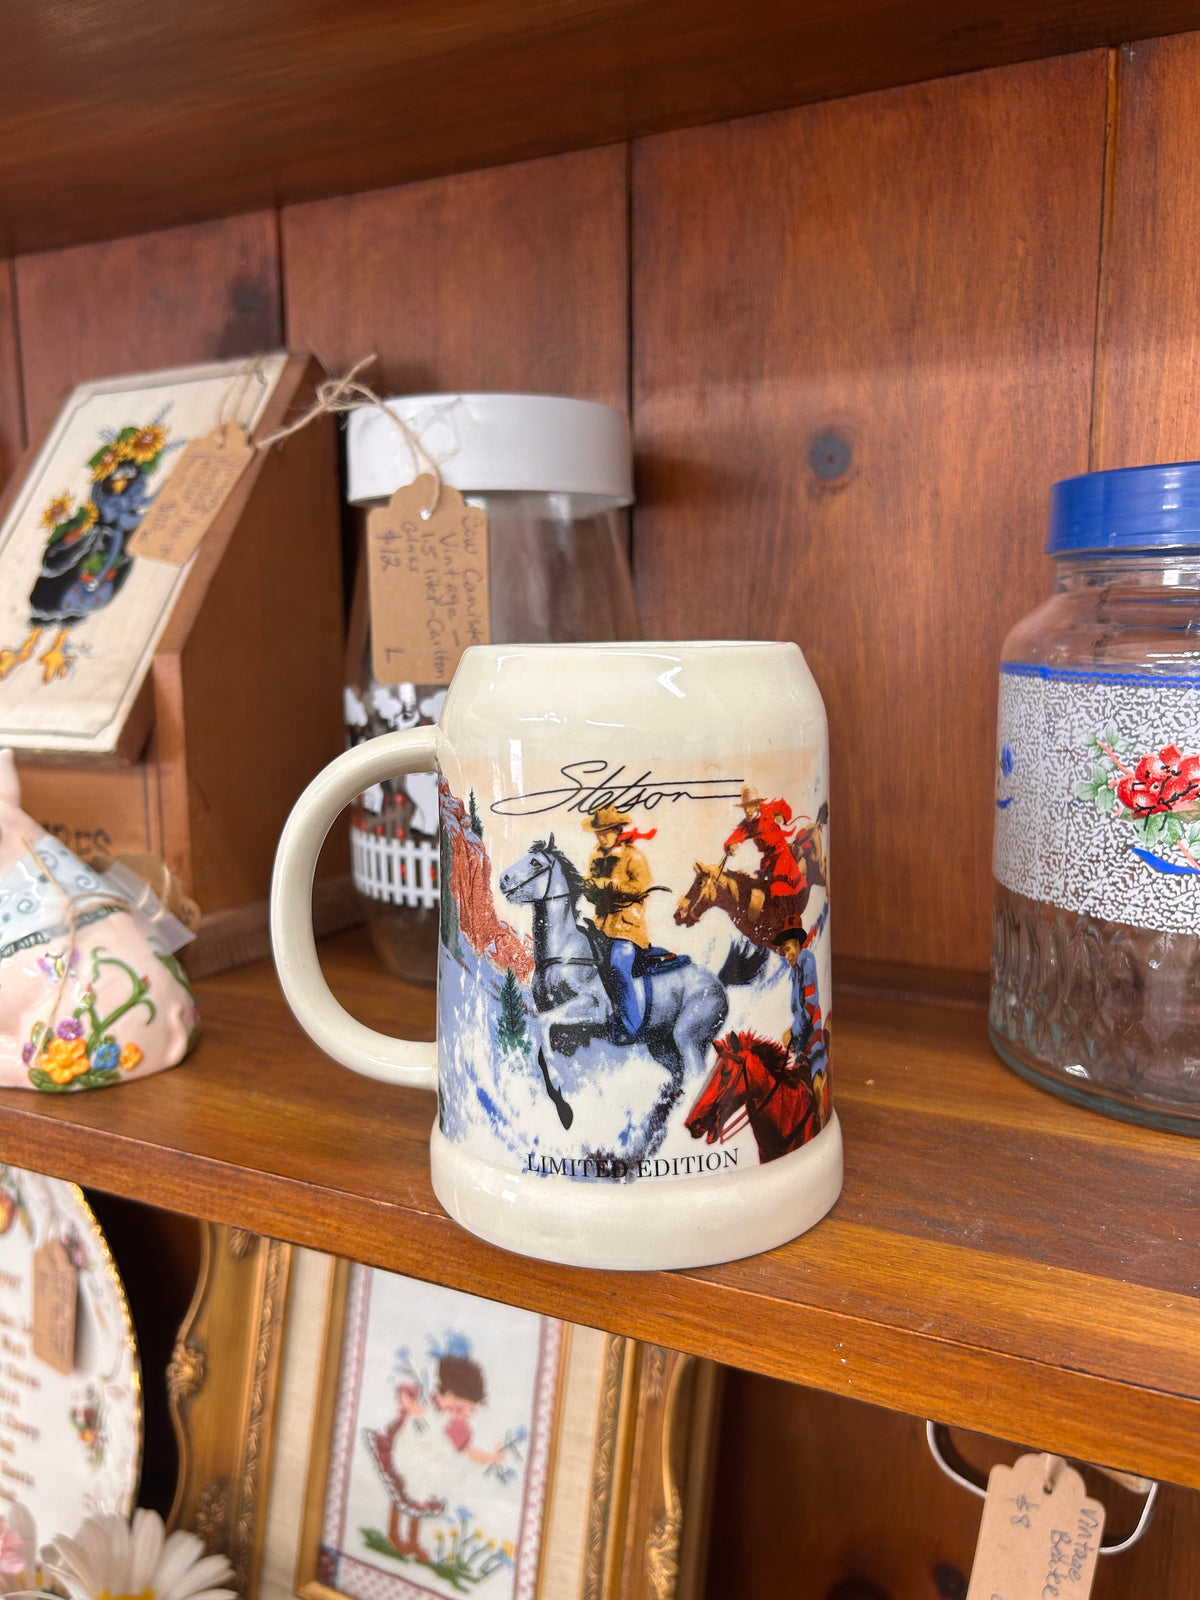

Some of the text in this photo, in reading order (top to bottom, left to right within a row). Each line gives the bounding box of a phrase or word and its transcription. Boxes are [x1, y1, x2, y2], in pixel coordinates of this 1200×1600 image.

[374, 528, 402, 573] $12
[463, 567, 485, 646] Caniste
[490, 760, 744, 816] Stetson
[526, 1148, 740, 1178] LIMITED EDITION
[1006, 1493, 1040, 1529] $8
